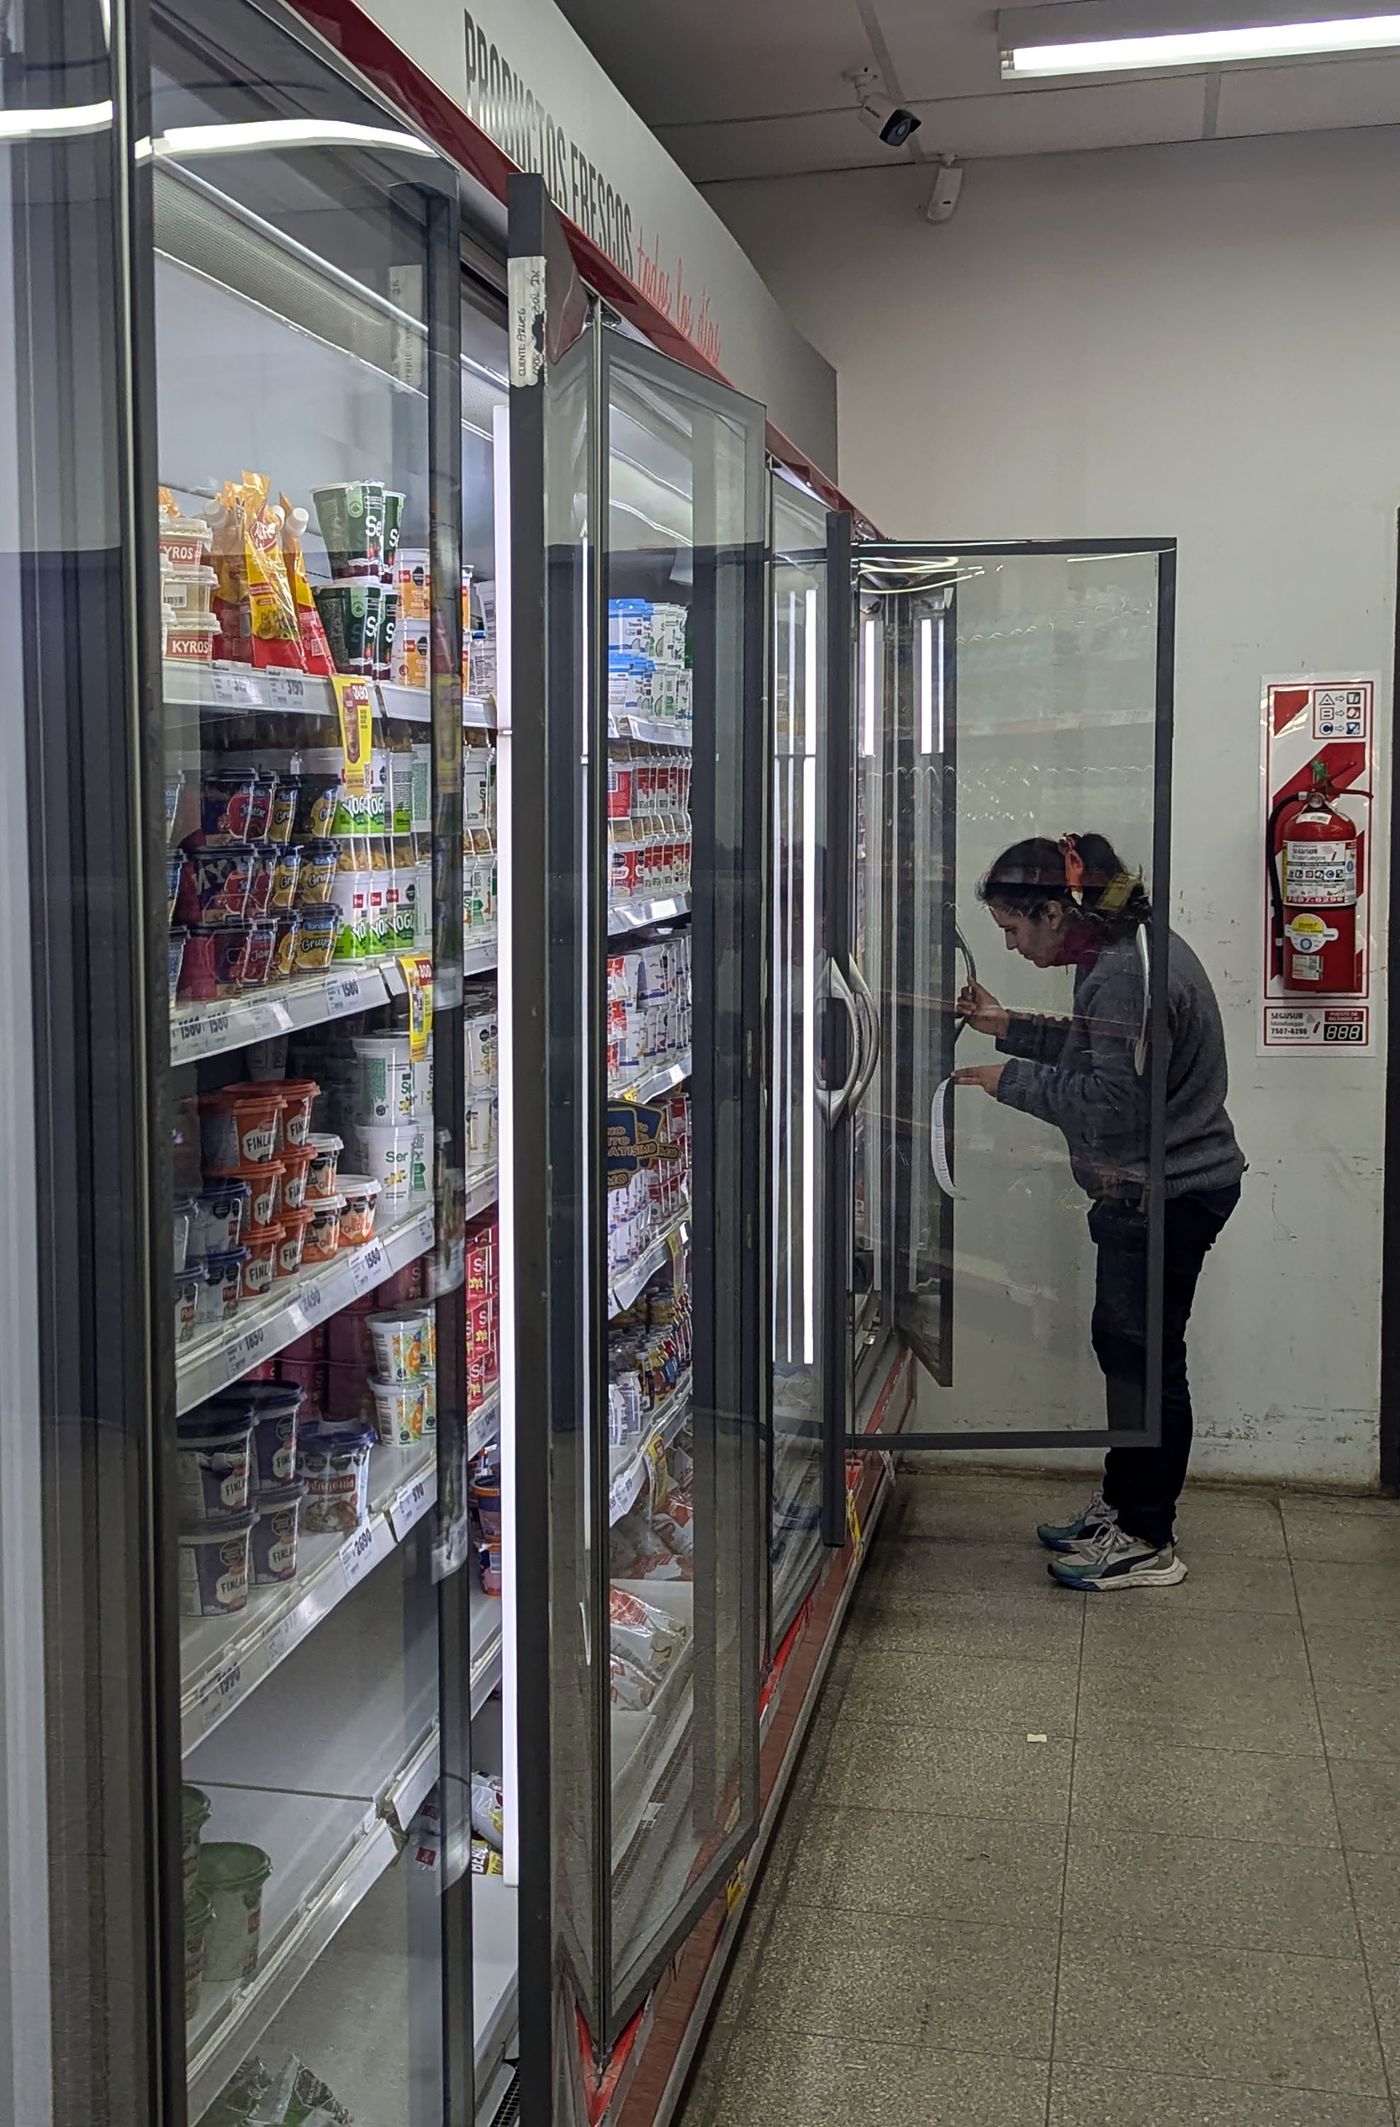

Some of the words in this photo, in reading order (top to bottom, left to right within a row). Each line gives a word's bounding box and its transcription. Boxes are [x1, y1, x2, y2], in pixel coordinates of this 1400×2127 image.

[464, 8, 568, 212] PRODUCTOS
[571, 140, 634, 278] FRESCOS
[159, 545, 194, 560] YROS
[172, 641, 209, 654] KYROS
[342, 979, 360, 998] 1580
[366, 1247, 381, 1270] 1580
[356, 1527, 372, 1554] 2690
